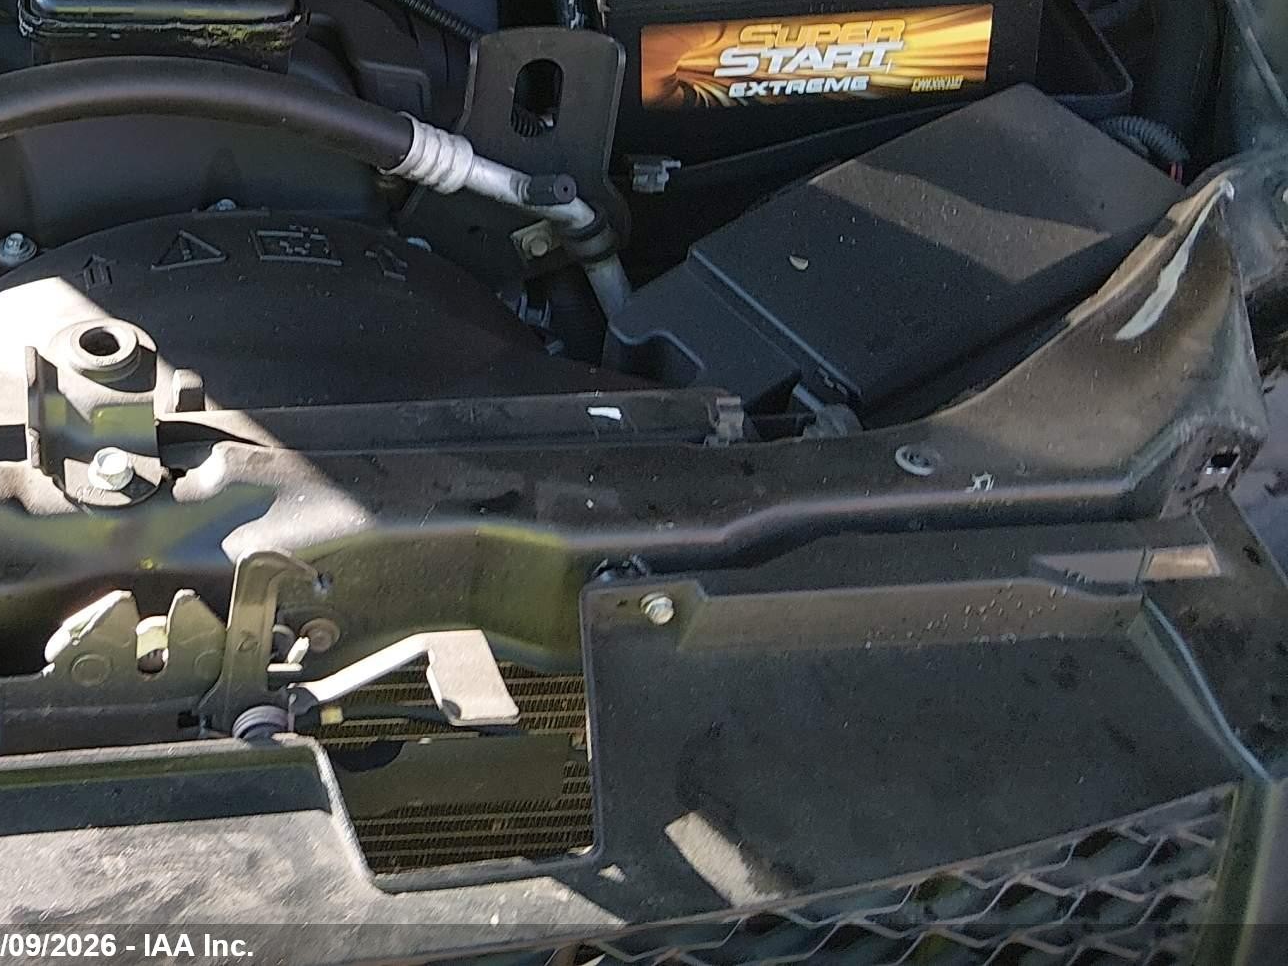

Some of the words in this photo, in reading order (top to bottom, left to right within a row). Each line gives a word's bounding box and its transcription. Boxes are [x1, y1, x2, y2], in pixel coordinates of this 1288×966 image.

[739, 19, 906, 48] SUPER
[714, 41, 903, 77] START
[729, 76, 869, 98] EXTREME
